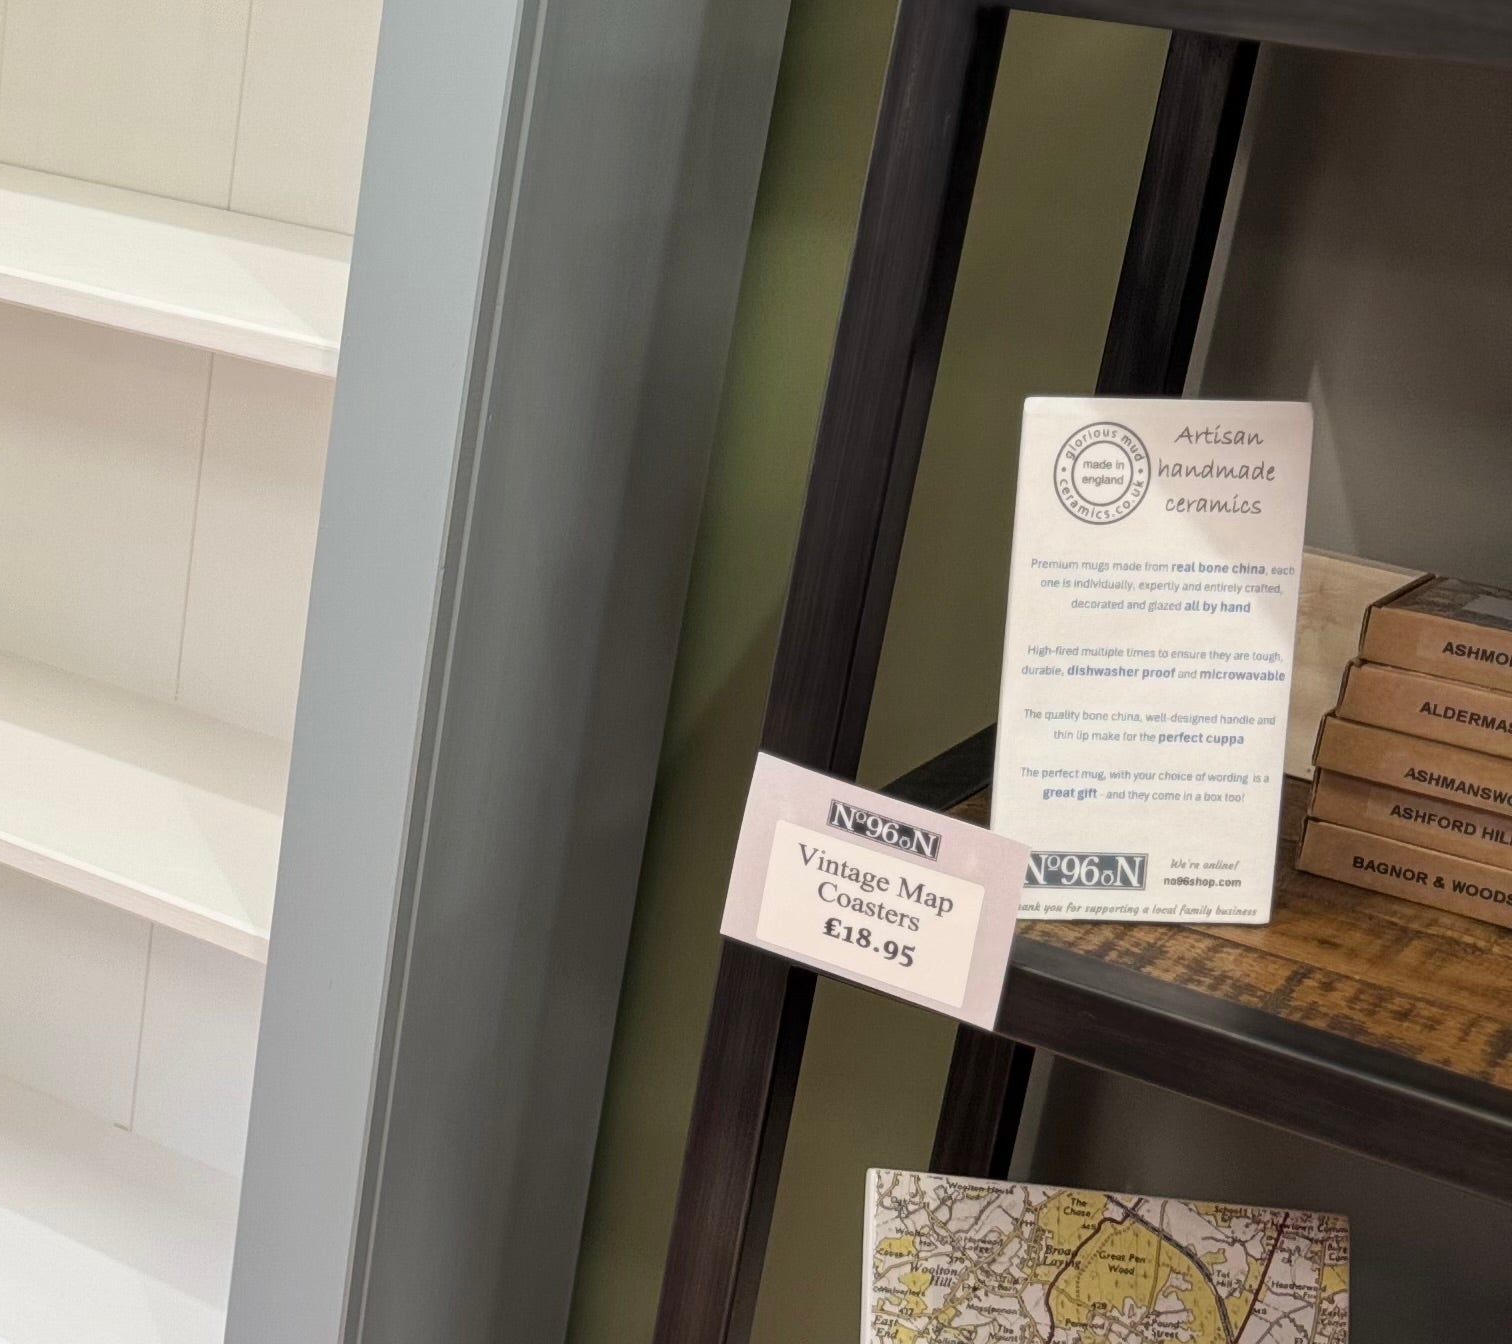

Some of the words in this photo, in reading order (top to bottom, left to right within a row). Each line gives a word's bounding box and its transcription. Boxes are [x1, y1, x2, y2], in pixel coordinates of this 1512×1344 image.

[1174, 425, 1263, 445] Artisan
[1065, 428, 1117, 460] glorious
[1121, 434, 1144, 462] mud
[1083, 460, 1112, 469] made
[1116, 460, 1125, 469] in
[1158, 458, 1275, 481] handmade
[1082, 475, 1123, 487] england
[1059, 478, 1144, 520] ceramics.co.uk
[1166, 494, 1262, 514] ceramics
[1031, 559, 1078, 570] Premium
[1082, 562, 1109, 572] mugs
[1113, 561, 1141, 571] made
[1145, 561, 1168, 572] from
[1171, 562, 1195, 573] real
[1198, 563, 1228, 574] bone
[1232, 564, 1268, 576] china,
[1271, 566, 1295, 575] each
[1063, 579, 1071, 588] is
[1074, 579, 1136, 591] individually,
[1139, 581, 1179, 593] expertly
[1182, 582, 1201, 591] and
[1204, 583, 1242, 595] entirely
[1245, 584, 1283, 594] crafted,
[1072, 599, 1124, 609] decorated
[1127, 600, 1145, 610] and
[1148, 601, 1182, 612] glazed
[1185, 601, 1200, 611] all
[1203, 602, 1217, 613] by
[1220, 602, 1250, 613] hand
[1027, 645, 1079, 657] High-fired
[1082, 647, 1124, 658] multiple
[1127, 647, 1155, 658] times
[1159, 649, 1168, 658] to
[1171, 650, 1206, 660] ensure
[1209, 650, 1231, 662] they
[1234, 652, 1250, 660] are
[1252, 651, 1283, 663] tough,
[1442, 641, 1512, 667] ASHMO
[1022, 665, 1065, 677] durable,
[1068, 665, 1139, 678] dishwasher
[1142, 667, 1176, 679] proof
[1178, 669, 1197, 679] and
[1200, 669, 1285, 681] microwavable
[1024, 709, 1042, 719] The
[1045, 709, 1080, 722] quality
[1083, 711, 1108, 721] bone
[1111, 712, 1143, 722] china,
[1146, 713, 1217, 725] well-designed
[1220, 714, 1255, 725] handle
[1257, 715, 1276, 725] and
[1054, 730, 1074, 740] thin
[1077, 731, 1089, 742] lip
[1092, 731, 1120, 741] make
[1123, 731, 1137, 741] for
[1140, 732, 1156, 742] the
[1158, 732, 1203, 745] perfect
[1206, 734, 1244, 746] cuppa
[1021, 767, 1039, 778] The
[1042, 768, 1079, 780] perfect
[1081, 770, 1107, 781] mug,
[1109, 770, 1131, 780] with
[1134, 771, 1156, 782] your
[1158, 771, 1193, 781] choice
[1196, 771, 1206, 781] of
[1208, 772, 1248, 785] wording
[1253, 773, 1261, 783] is
[1264, 775, 1270, 783] a
[1043, 788, 1075, 800] great
[1078, 788, 1098, 800] gift
[1106, 791, 1125, 800] and
[1128, 790, 1150, 802] they
[1152, 792, 1181, 801] come
[1183, 791, 1192, 801] in
[1195, 793, 1202, 801] a
[1204, 792, 1222, 802] box
[1225, 792, 1244, 802] too!
[1390, 804, 1476, 836] ASHFORD
[1481, 827, 1512, 845] HIL
[1170, 858, 1200, 869] We're
[1203, 859, 1240, 871] online!
[1352, 855, 1429, 885] BAGNOR
[1433, 875, 1446, 890] &
[798, 842, 890, 893] Vintage
[897, 877, 954, 917] Map
[1164, 876, 1242, 889] no96shop.com
[817, 881, 920, 933] Coasters
[1044, 905, 1063, 914] you
[1065, 902, 1082, 915] for
[1085, 904, 1140, 917] supporting
[1152, 905, 1176, 915] local
[1179, 905, 1212, 917] family
[1216, 905, 1257, 916] business
[822, 917, 916, 968] £18.95
[1098, 1251, 1124, 1261] Great
[1128, 1253, 1146, 1263] Pen
[910, 1263, 958, 1276] Woolton
[1108, 1264, 1135, 1276] Wood
